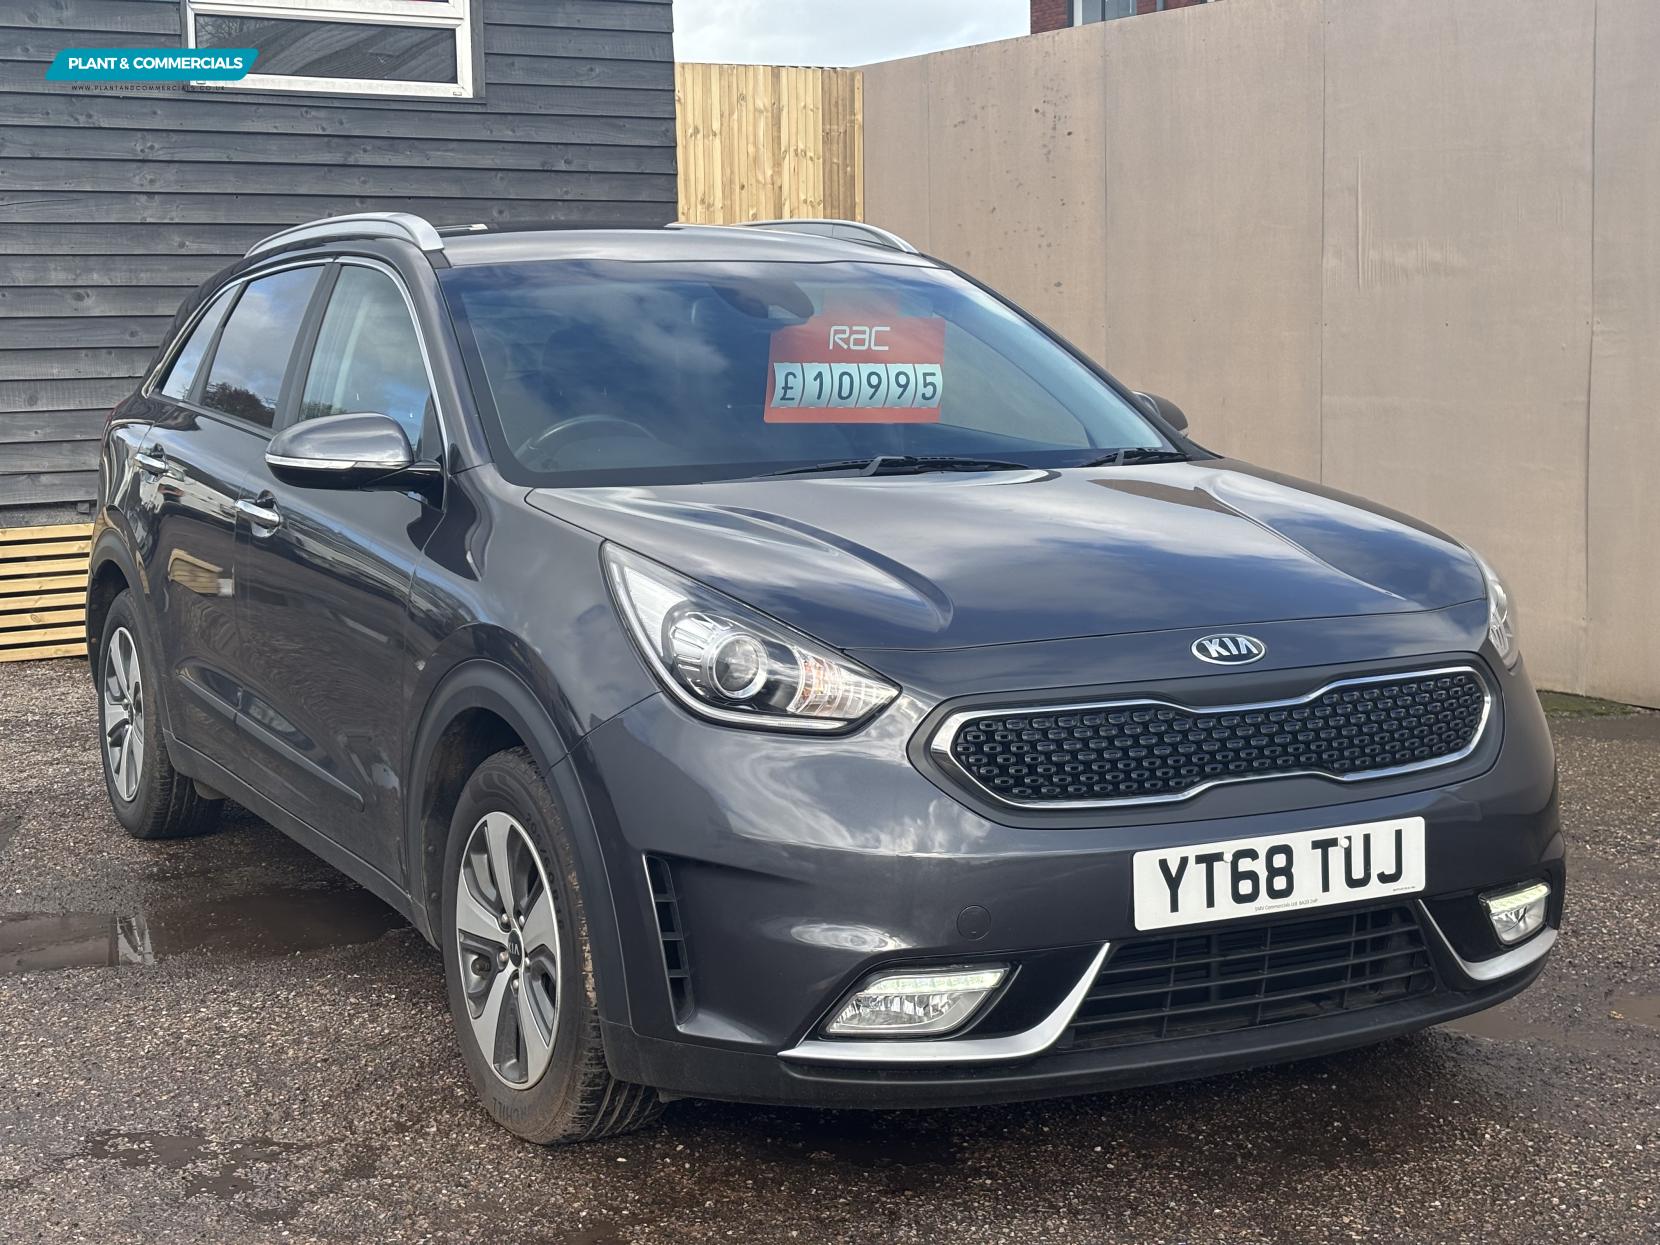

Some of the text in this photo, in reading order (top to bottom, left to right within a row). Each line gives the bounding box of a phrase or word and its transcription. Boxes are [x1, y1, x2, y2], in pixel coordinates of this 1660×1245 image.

[780, 371, 937, 401] £10995
[1201, 637, 1259, 658] KIA
[1158, 828, 1403, 914] YT68 TUJ
